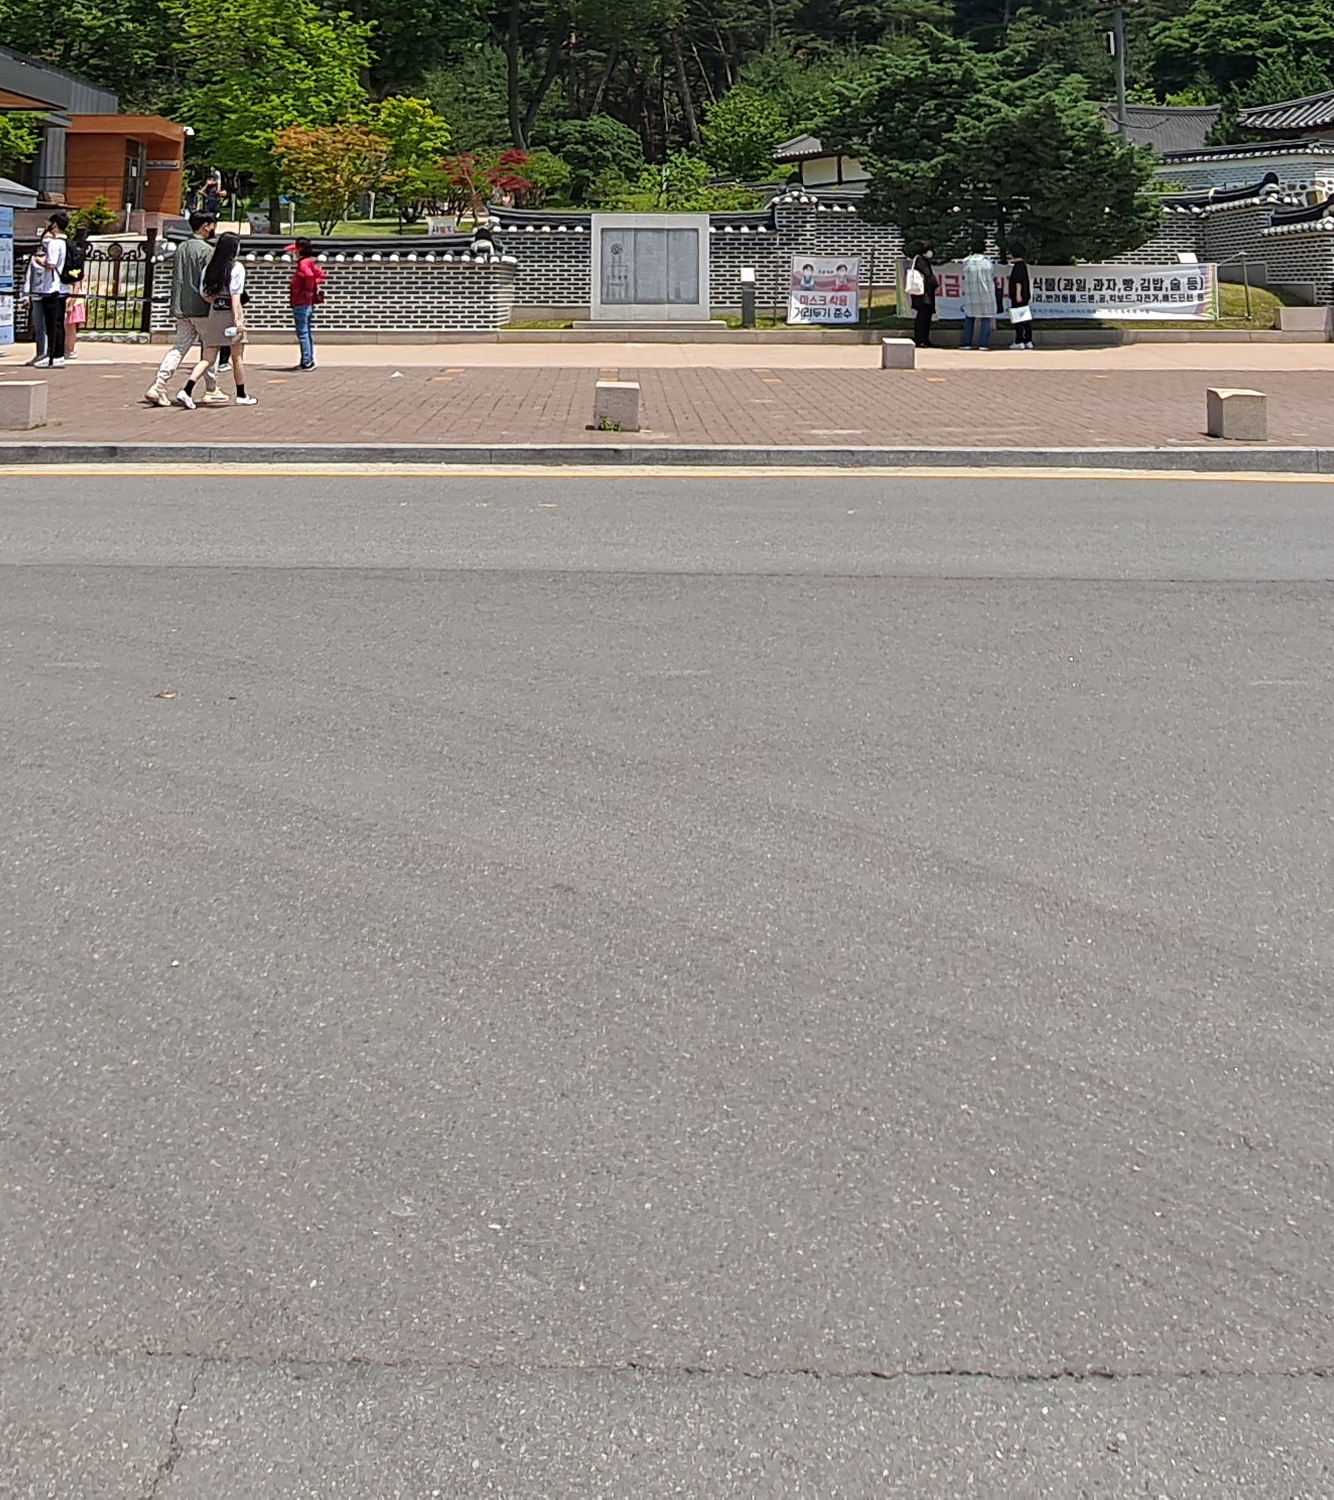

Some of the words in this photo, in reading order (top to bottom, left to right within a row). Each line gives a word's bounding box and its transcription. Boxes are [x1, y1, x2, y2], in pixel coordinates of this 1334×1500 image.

[1186, 275, 1205, 292] 등)
[792, 307, 831, 319] 거리두기
[833, 307, 853, 319] 준수
